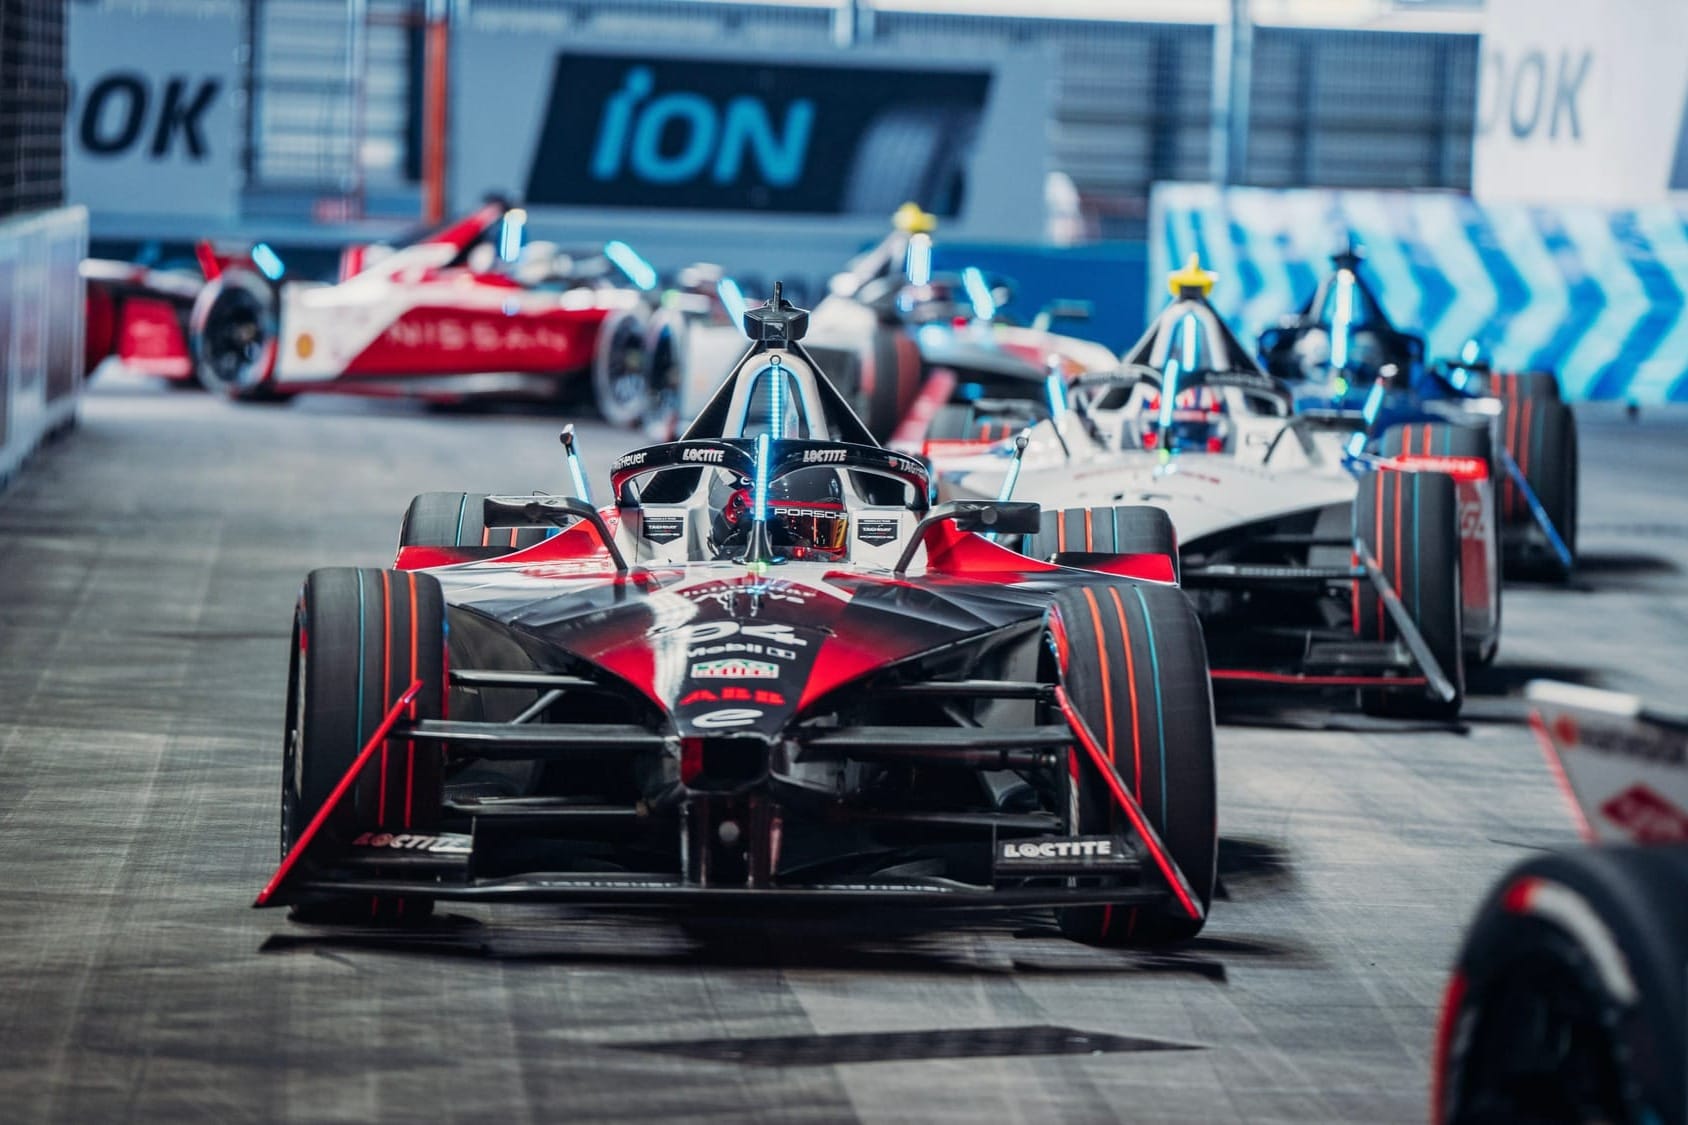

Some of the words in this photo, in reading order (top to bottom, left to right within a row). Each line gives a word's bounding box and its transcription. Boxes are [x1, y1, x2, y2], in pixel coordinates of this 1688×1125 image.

[66, 72, 222, 161] OK
[682, 448, 725, 463] LOCTITE
[802, 449, 847, 463] LOCTITE
[686, 643, 763, 658] Mobil
[678, 686, 786, 706] ABB
[1003, 839, 1111, 858] LOCTITE
